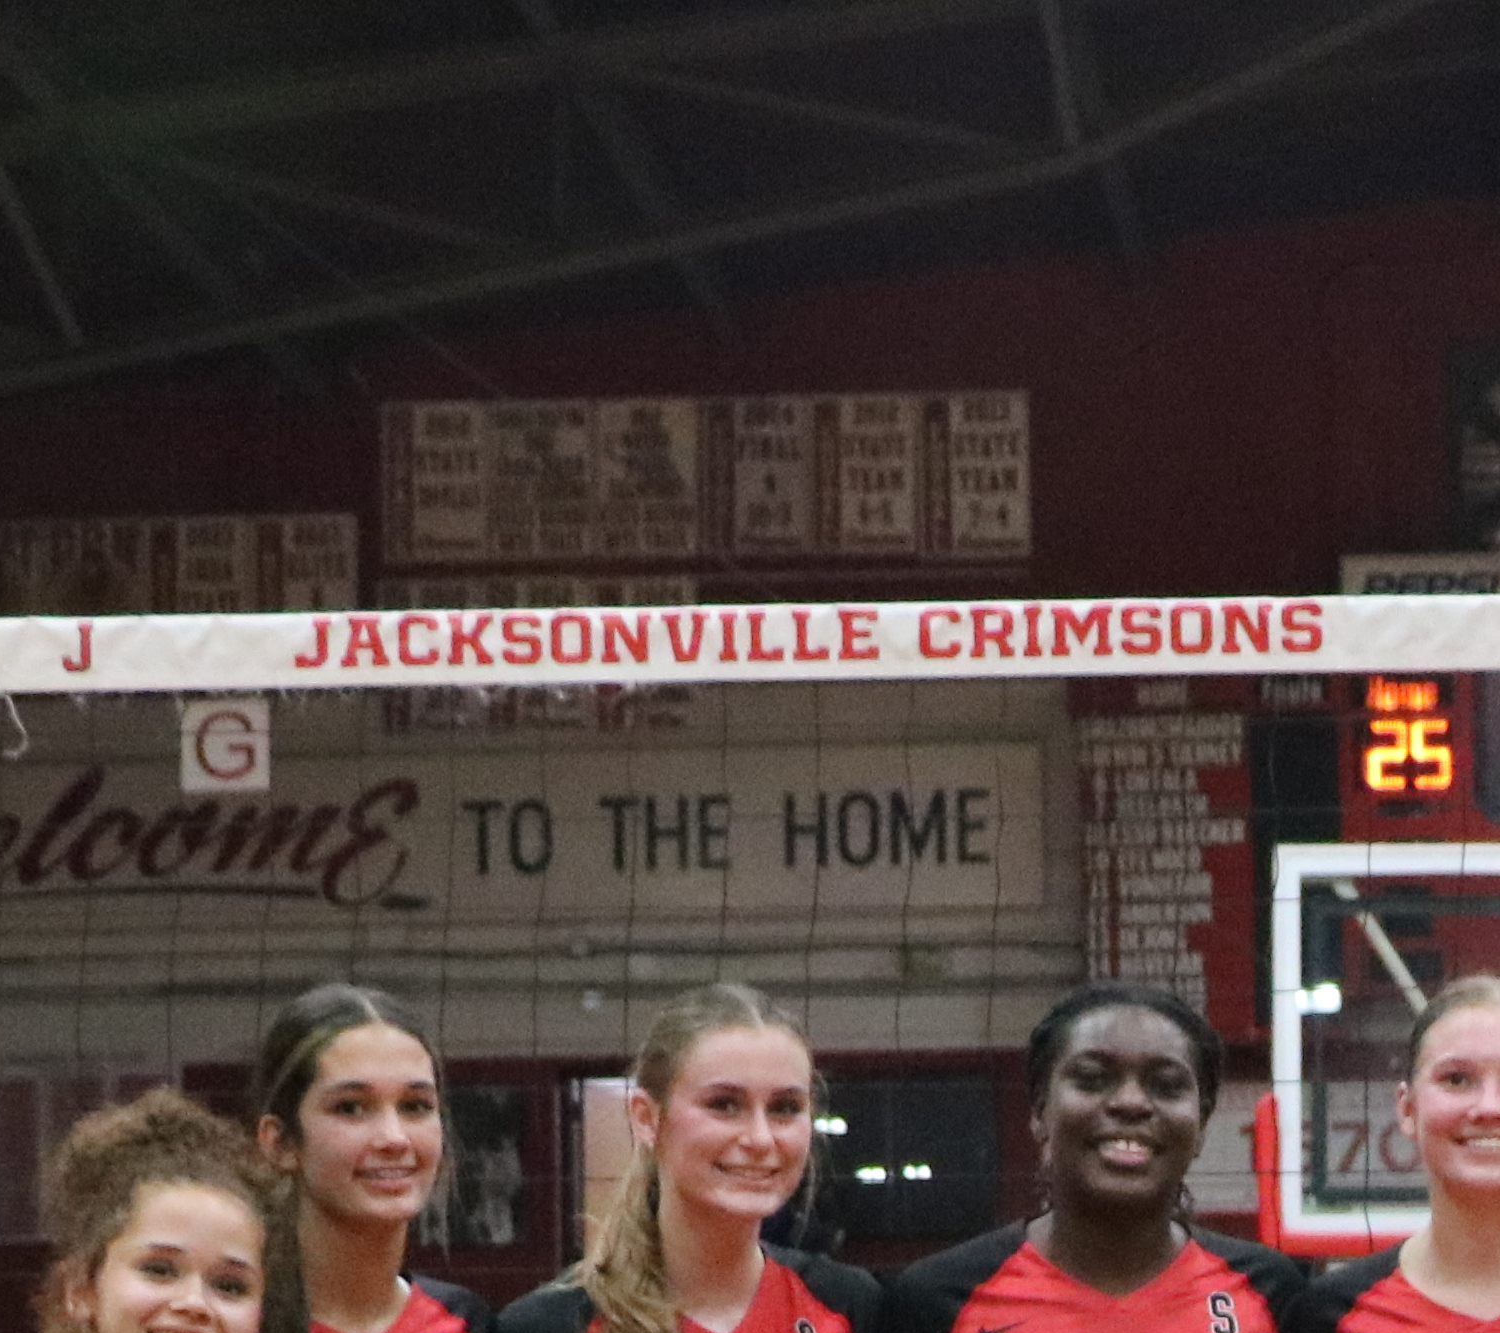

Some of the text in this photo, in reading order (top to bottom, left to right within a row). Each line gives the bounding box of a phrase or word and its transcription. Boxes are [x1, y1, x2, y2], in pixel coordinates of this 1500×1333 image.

[62, 622, 93, 673] J
[293, 600, 1325, 670] JACKSONVILLE CRIMSONS
[195, 709, 257, 781] G
[1366, 719, 1453, 791] 25
[462, 799, 553, 877] TO
[600, 793, 731, 872] THE
[782, 788, 992, 870] HOME
